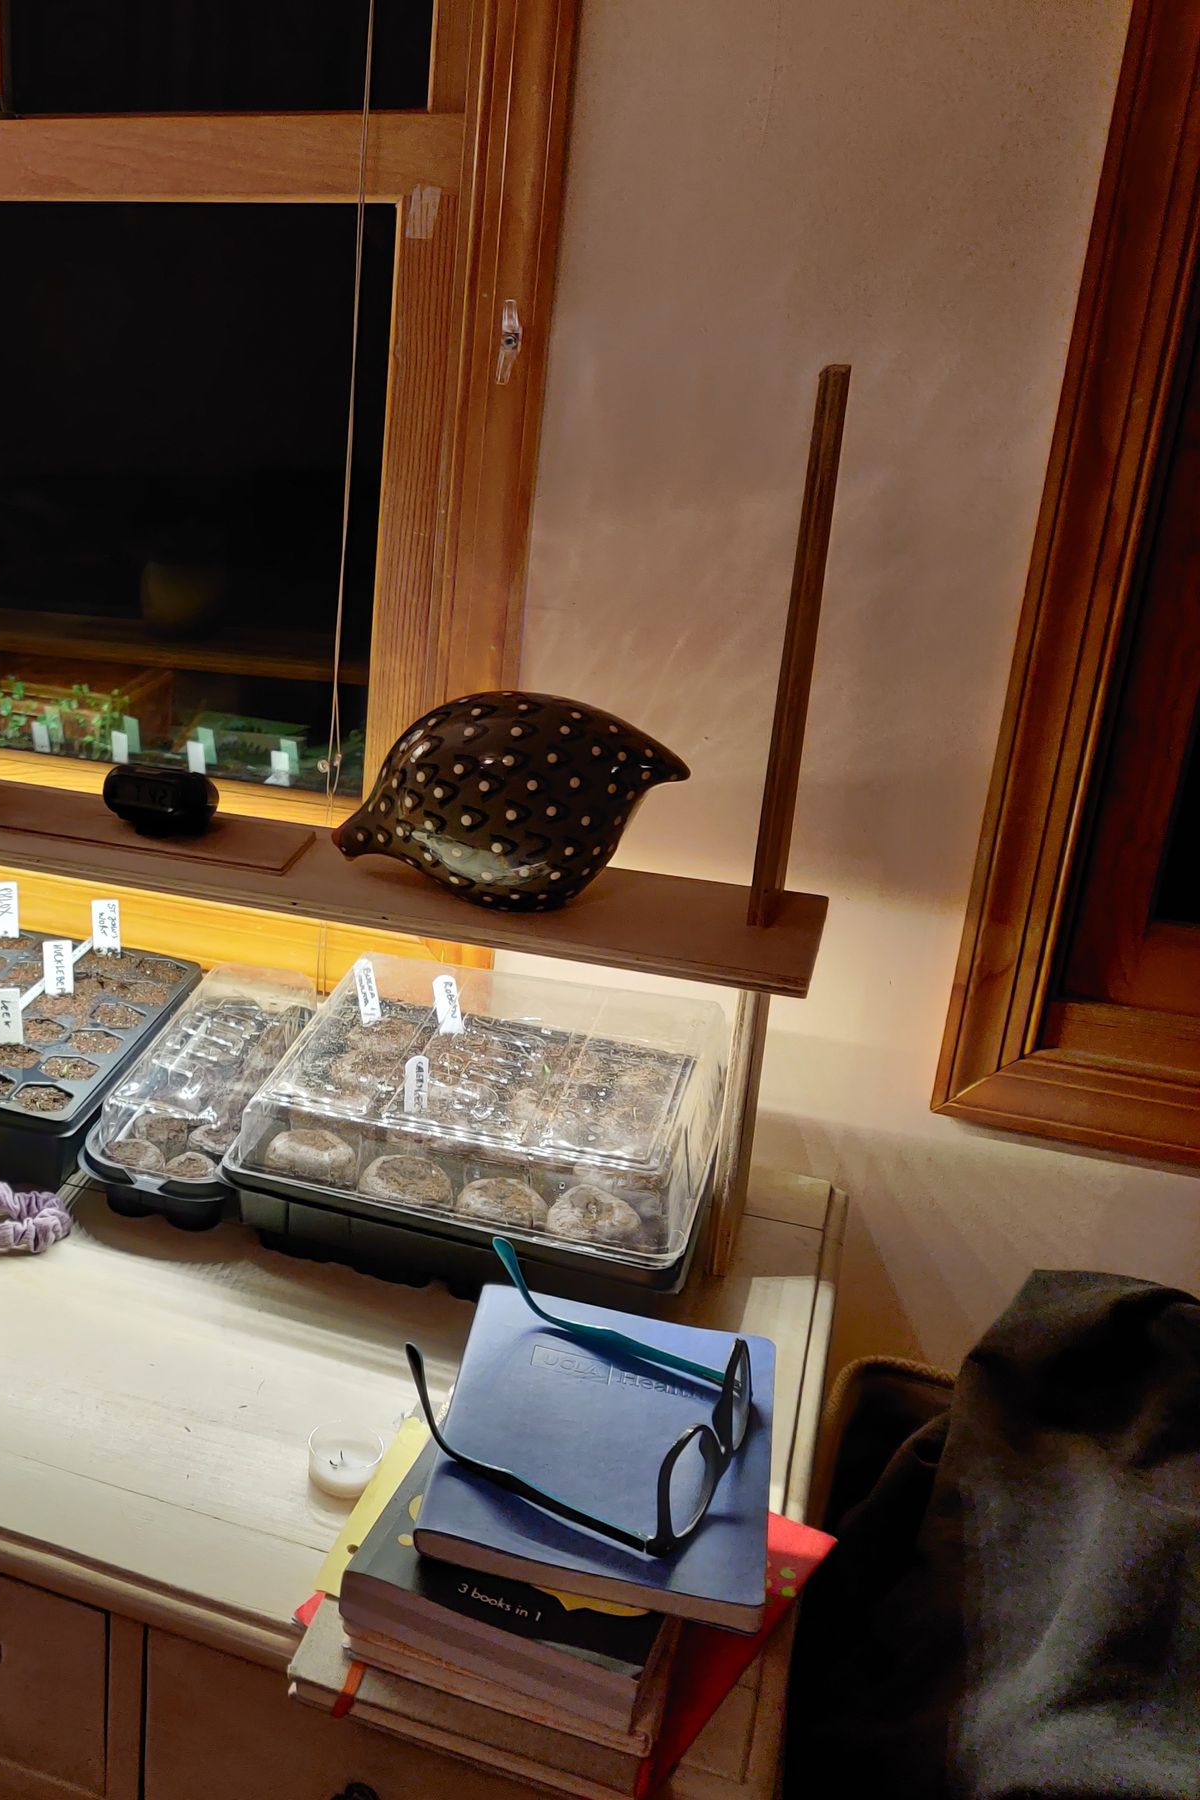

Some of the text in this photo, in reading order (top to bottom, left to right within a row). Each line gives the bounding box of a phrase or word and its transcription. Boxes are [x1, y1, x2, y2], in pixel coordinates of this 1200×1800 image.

[0, 999, 12, 1029] LEEK
[542, 1353, 600, 1377] UCLA
[457, 1583, 542, 1622] 3 books in 1
